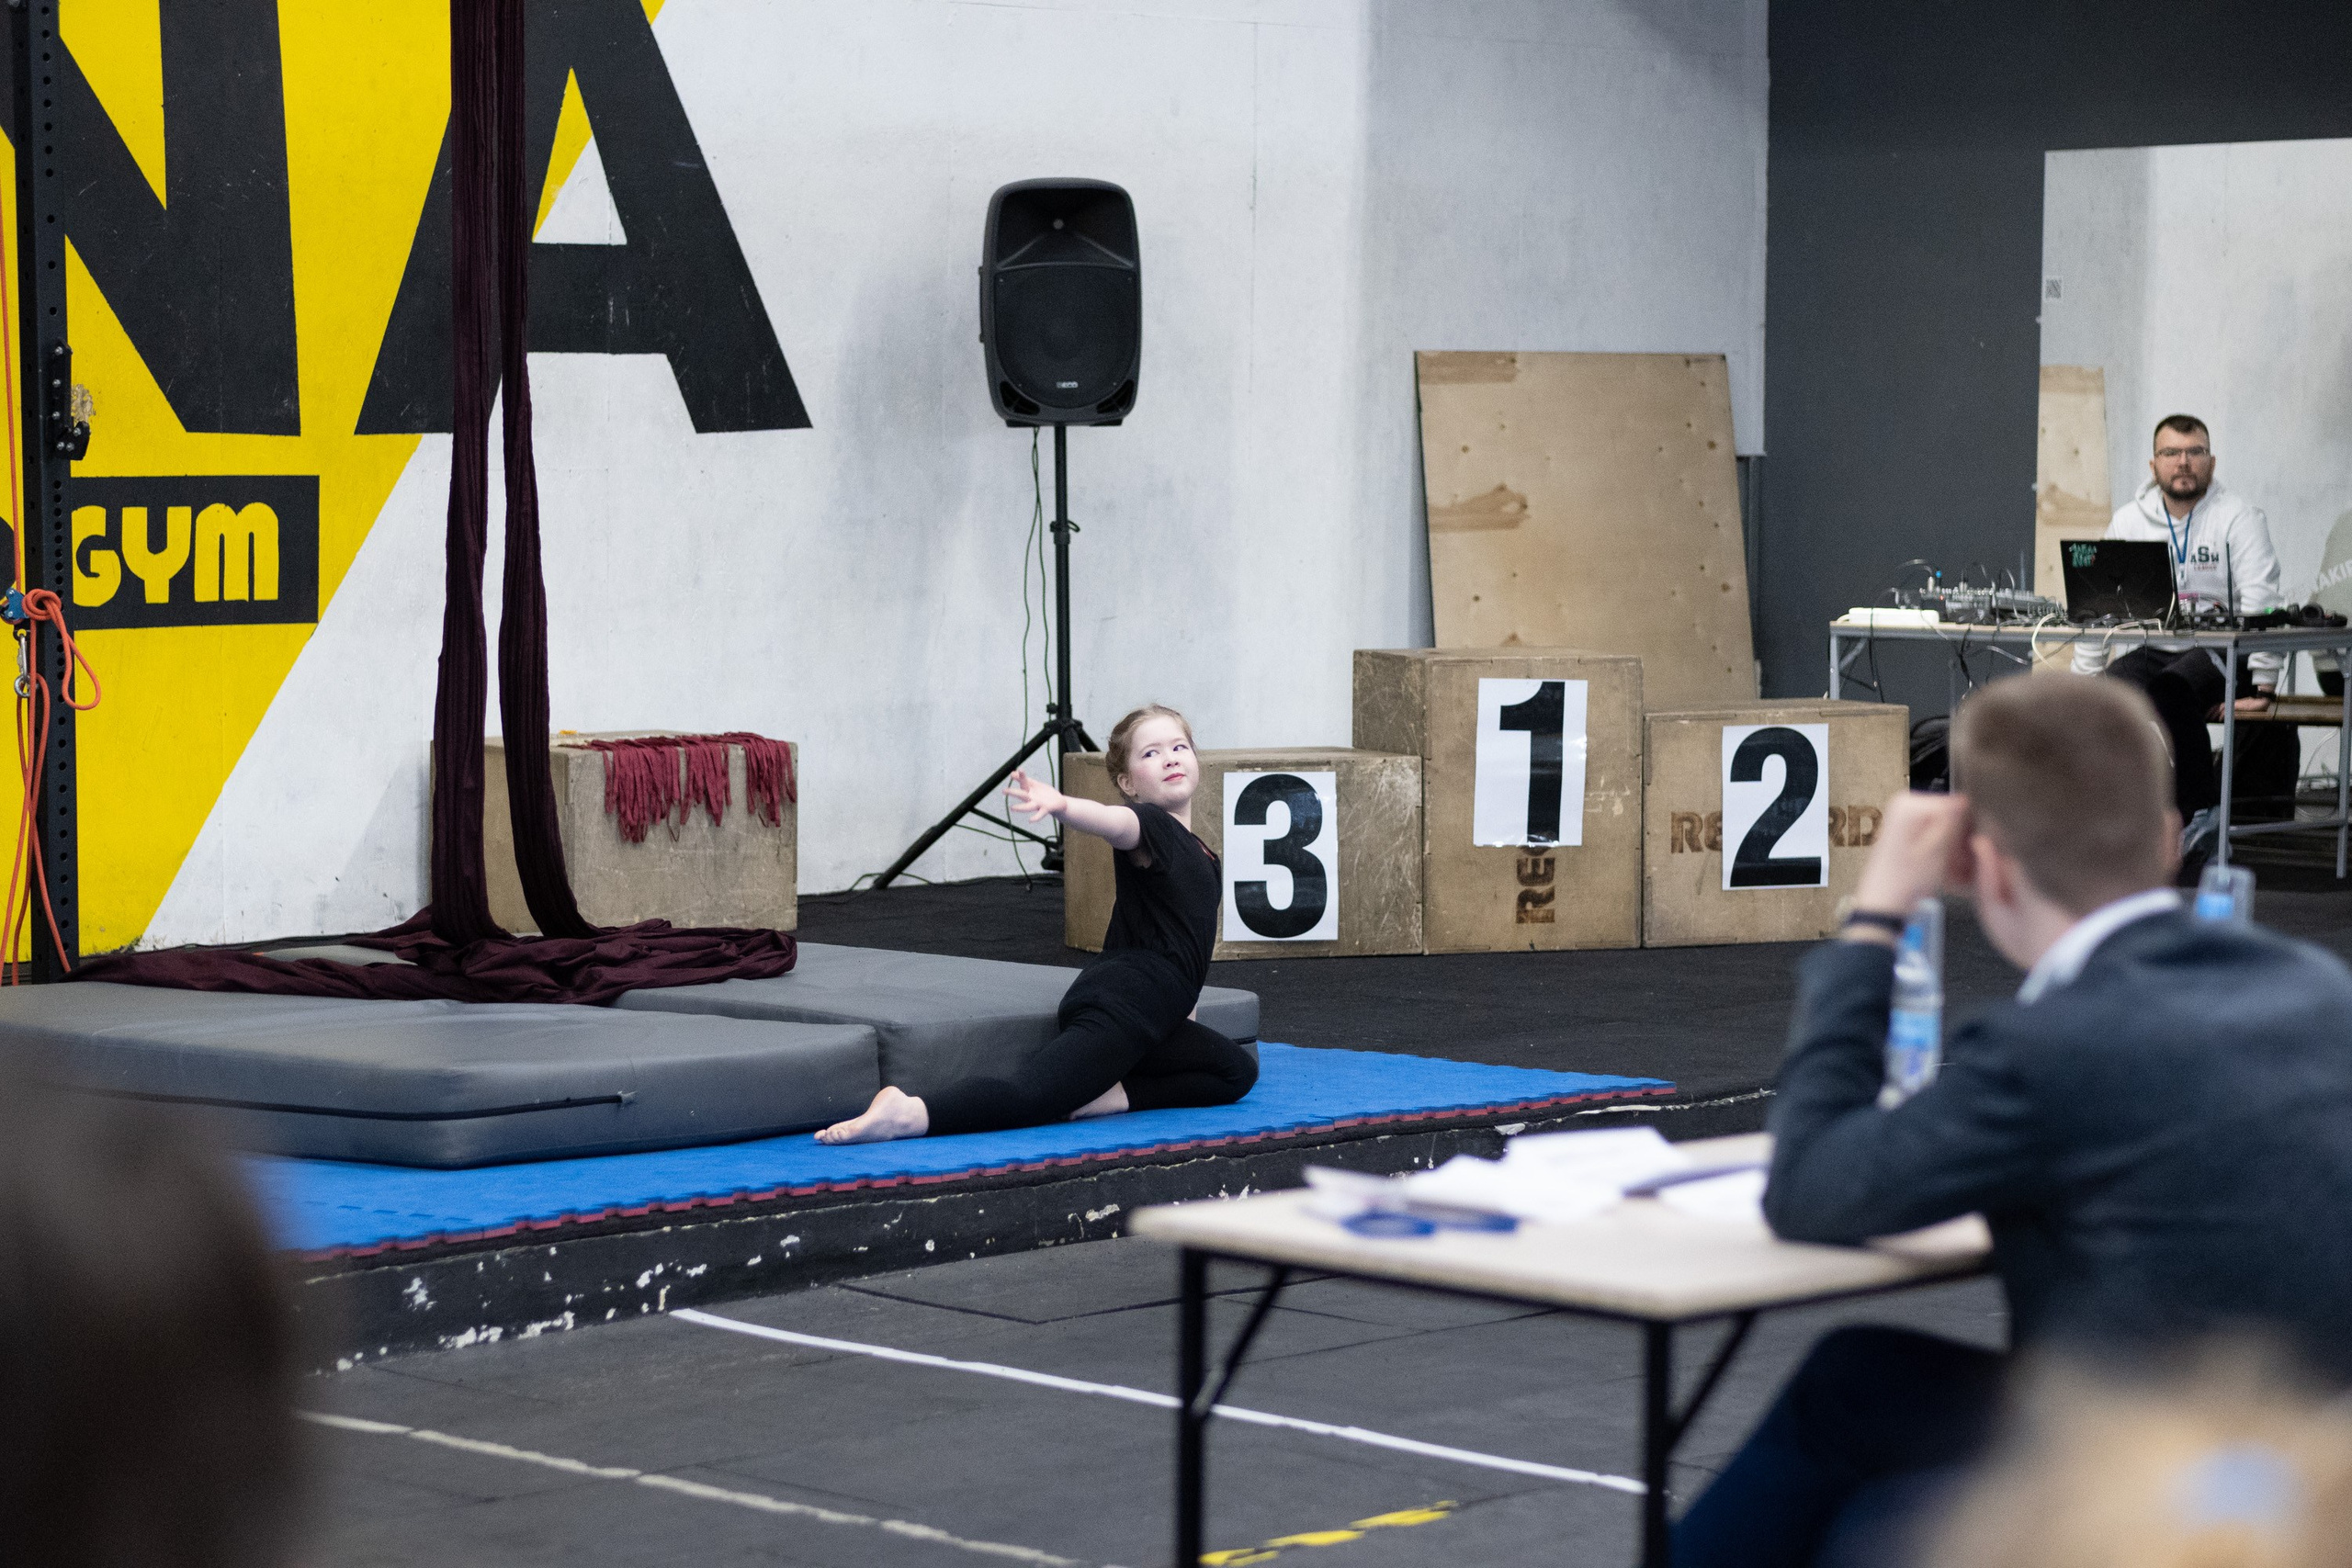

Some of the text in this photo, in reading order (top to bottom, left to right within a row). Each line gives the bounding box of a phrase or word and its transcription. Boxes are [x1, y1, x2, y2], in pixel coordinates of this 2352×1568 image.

[72, 502, 279, 607] GYM
[1499, 681, 1566, 843] 1
[1730, 727, 1822, 887] 2
[1234, 773, 1328, 939] 3
